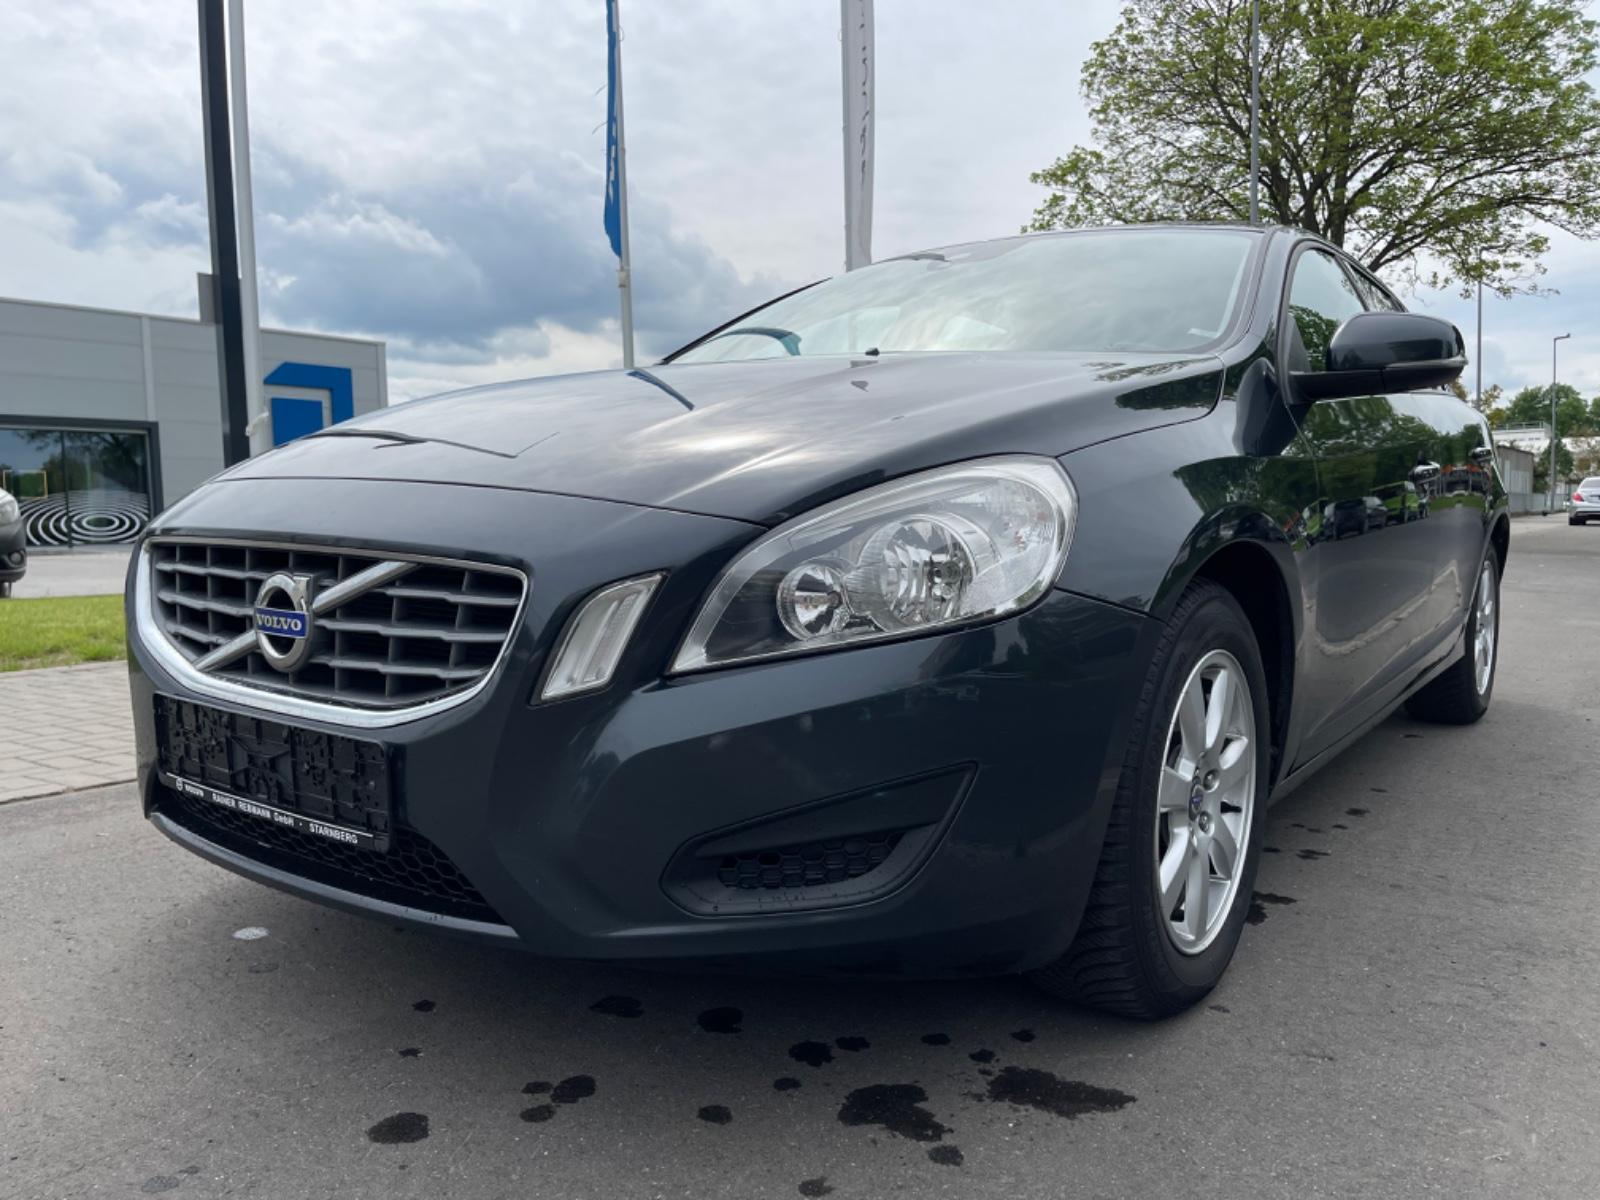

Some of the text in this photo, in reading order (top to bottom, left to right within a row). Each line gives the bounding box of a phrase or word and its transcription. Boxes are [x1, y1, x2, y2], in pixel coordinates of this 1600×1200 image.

[256, 614, 302, 631] VOLVO
[274, 812, 295, 827] GmbH
[309, 823, 358, 844] STARNBERG
